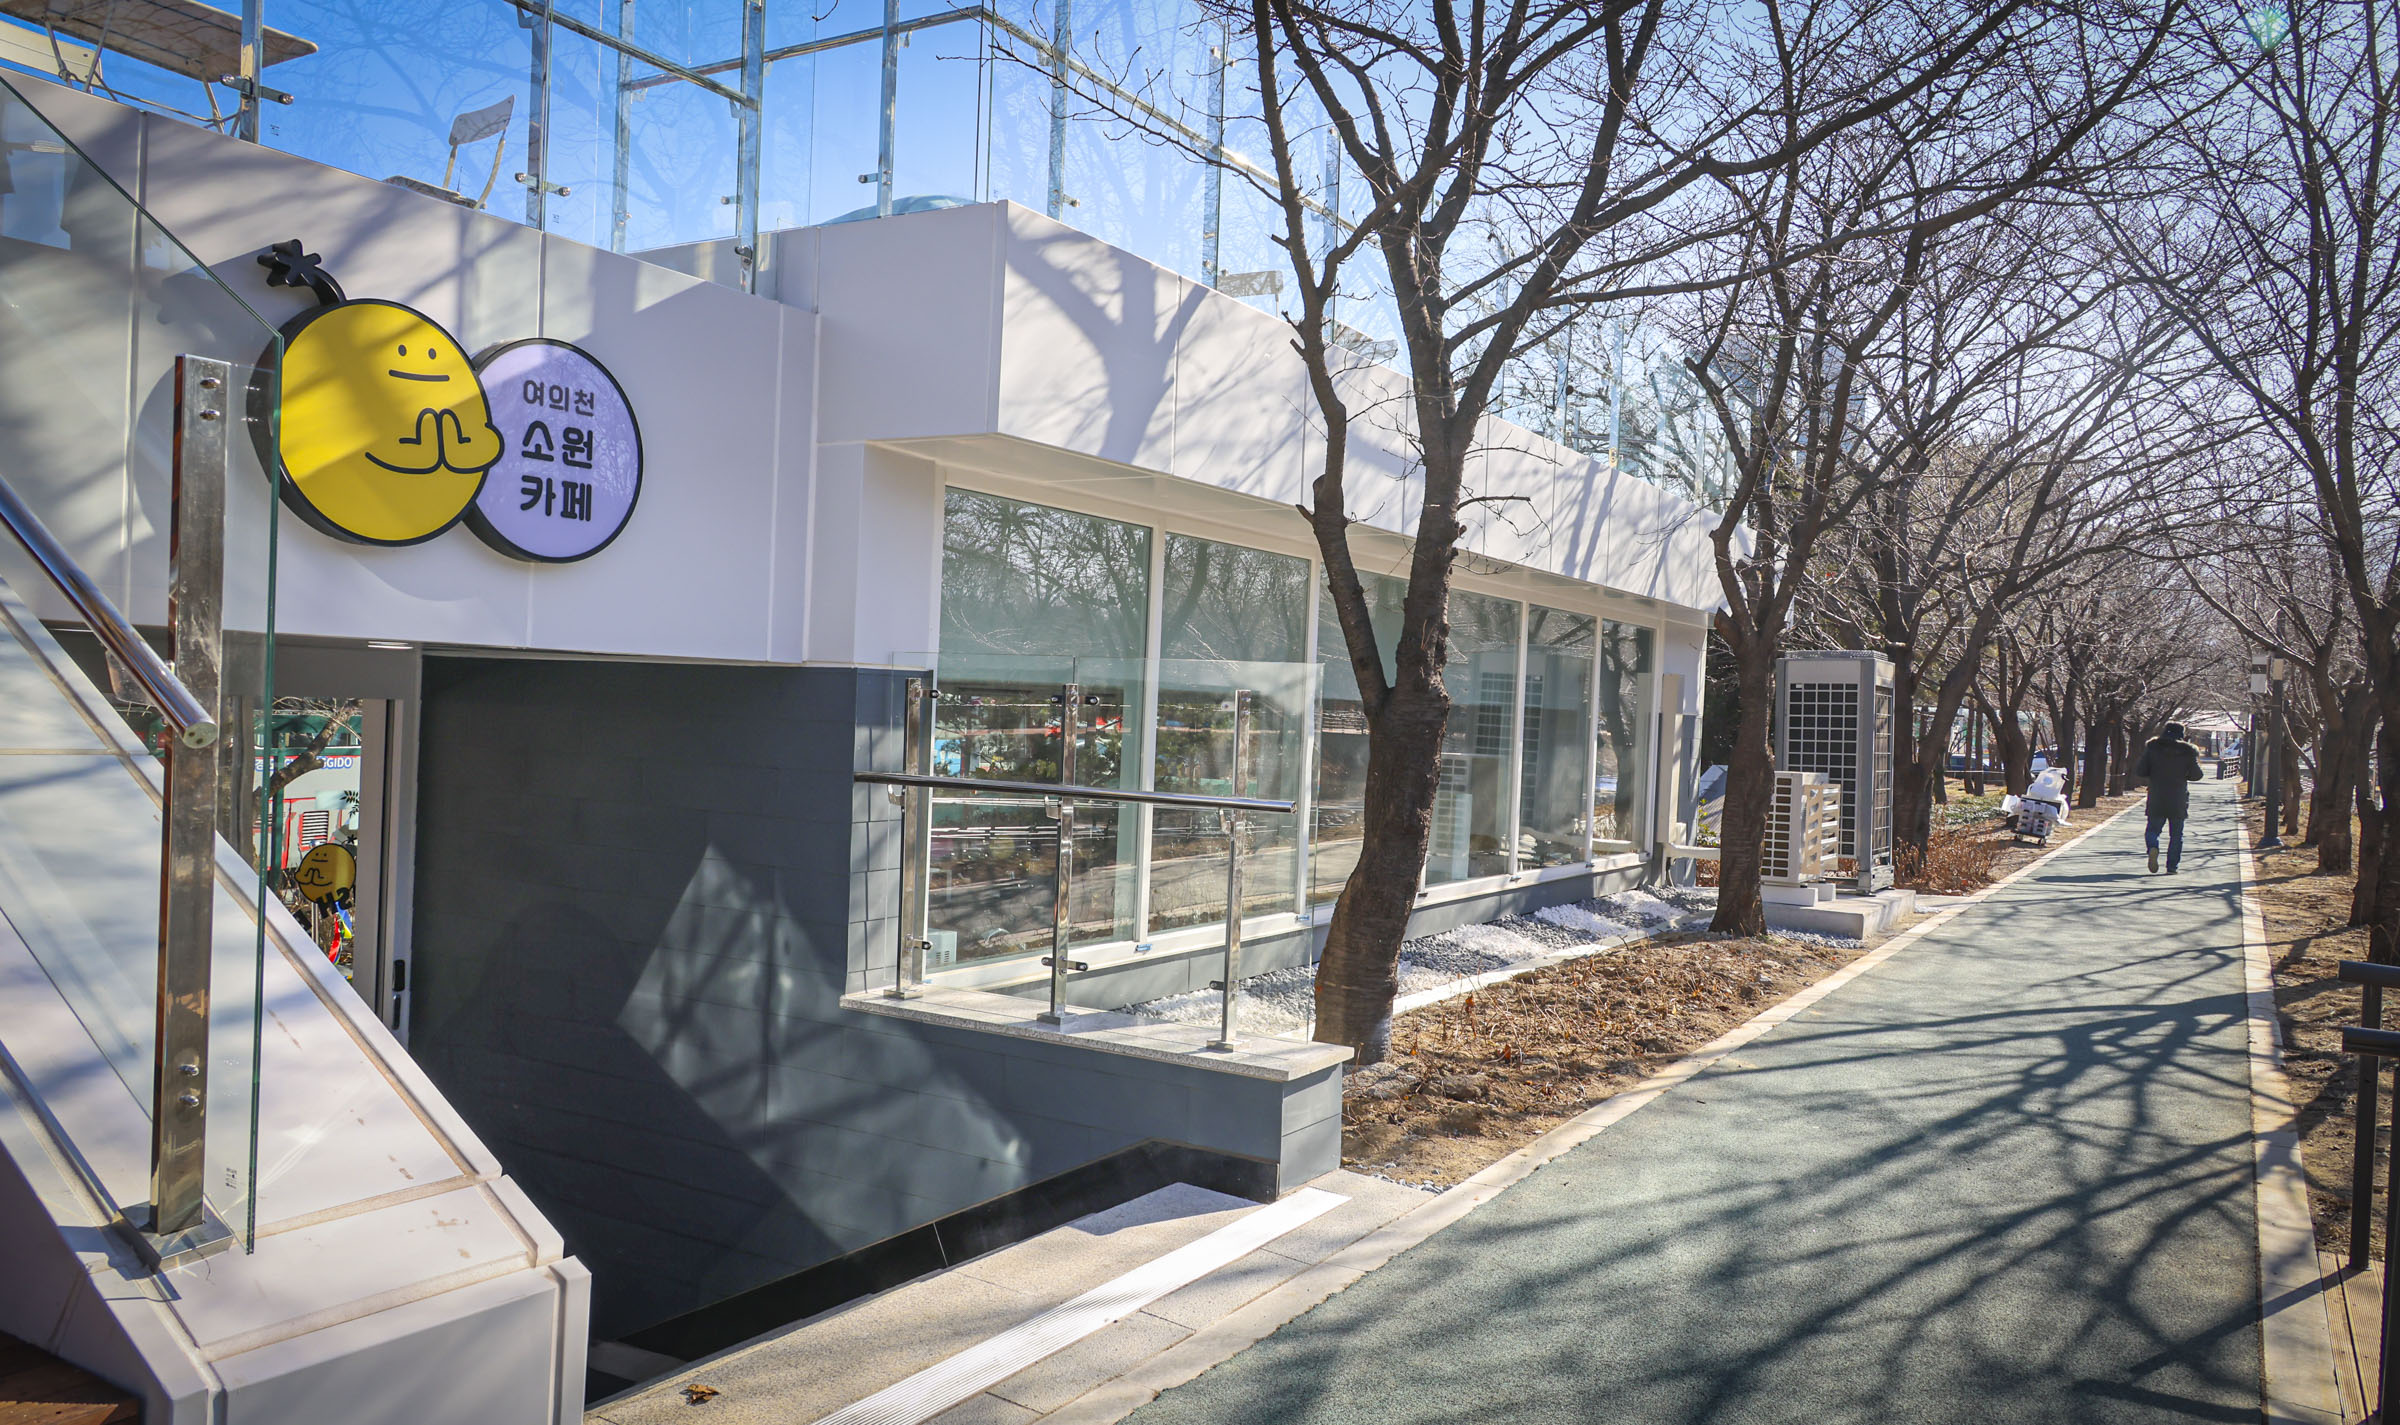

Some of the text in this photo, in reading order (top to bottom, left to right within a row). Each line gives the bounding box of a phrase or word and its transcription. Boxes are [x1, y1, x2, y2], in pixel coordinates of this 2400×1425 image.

[523, 380, 594, 416] 여의천
[522, 420, 593, 469] 소원
[520, 475, 592, 521] 카페
